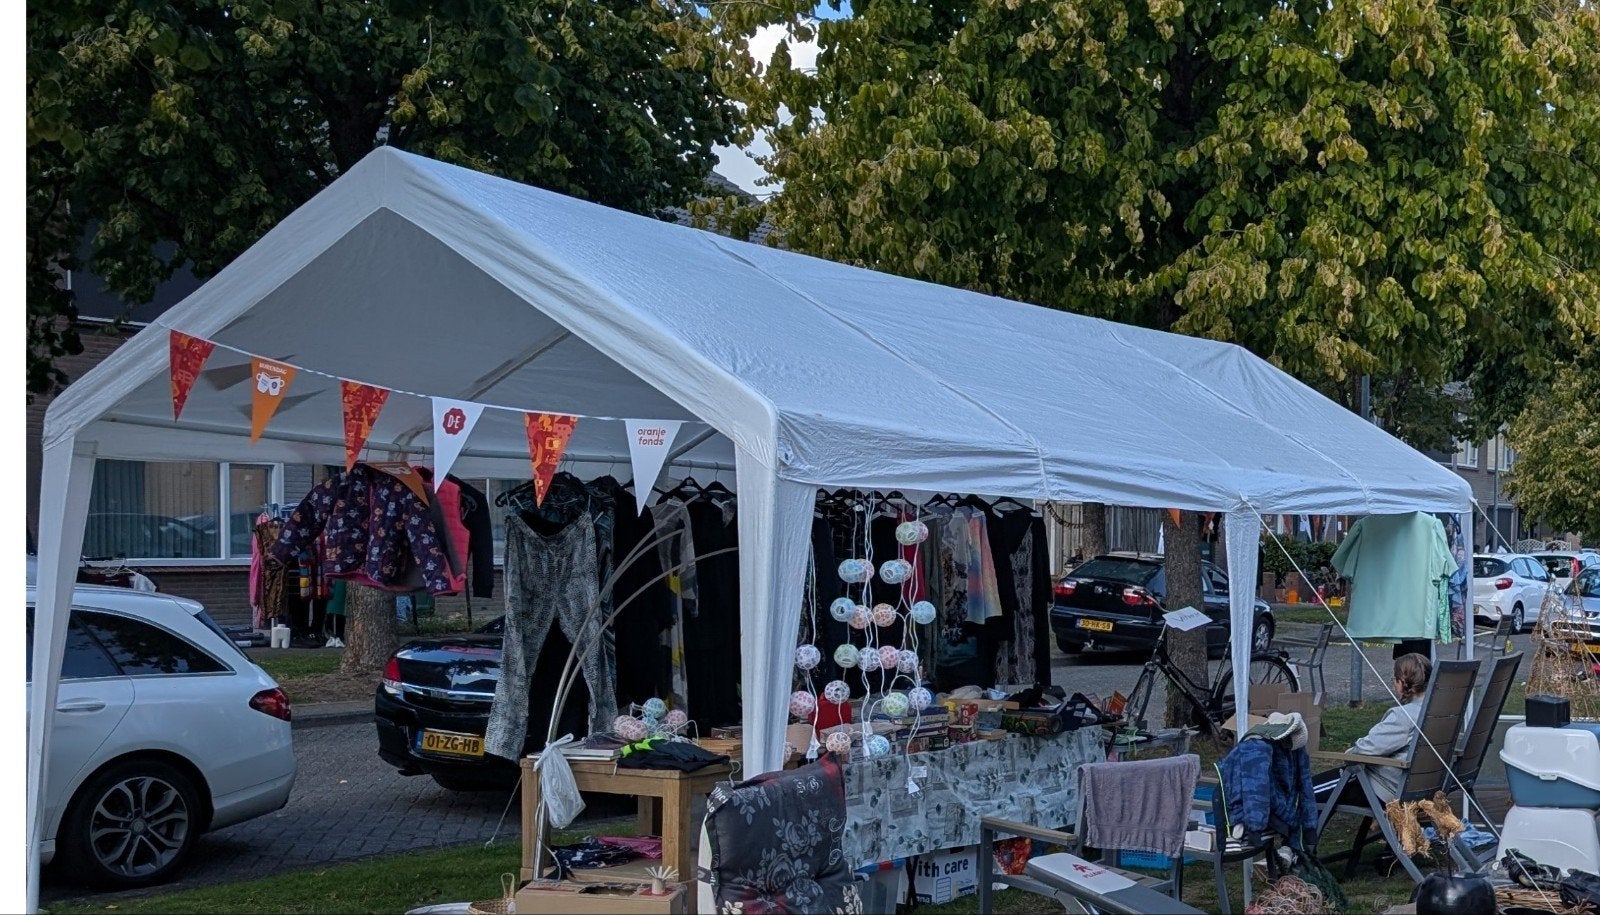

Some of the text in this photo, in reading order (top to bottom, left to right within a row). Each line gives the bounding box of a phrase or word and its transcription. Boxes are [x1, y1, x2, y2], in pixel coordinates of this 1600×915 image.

[637, 427, 666, 438] oranje
[638, 436, 664, 446] fonds
[426, 734, 480, 753] 01-ZG-HB
[916, 858, 969, 878] ith care
